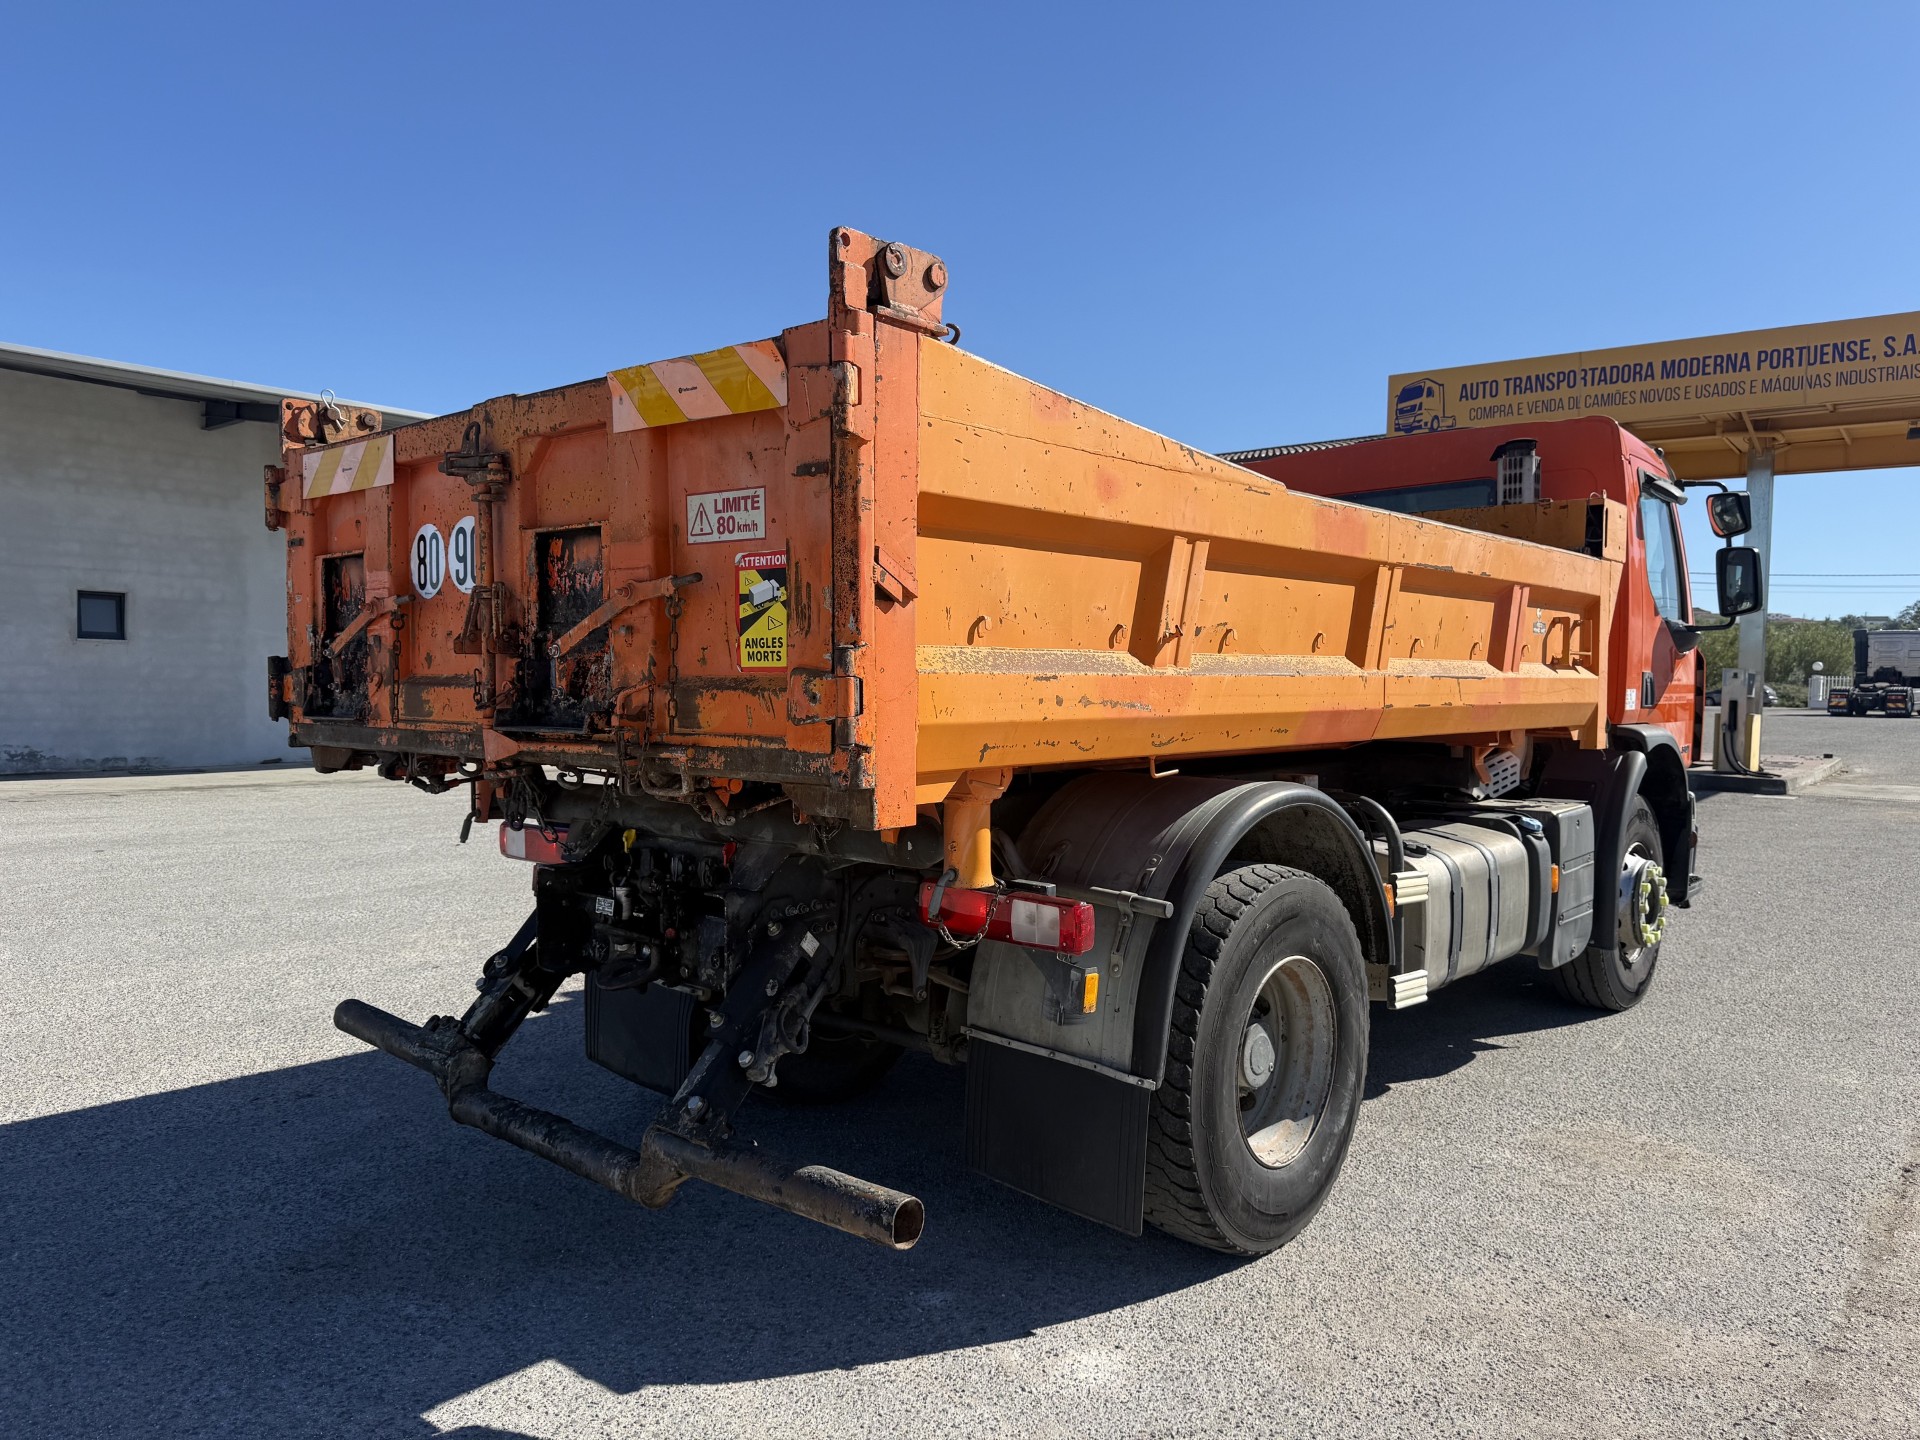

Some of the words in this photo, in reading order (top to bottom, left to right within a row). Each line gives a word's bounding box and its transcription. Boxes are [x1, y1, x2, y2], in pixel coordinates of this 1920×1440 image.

[1459, 379, 1499, 402] AUTO
[1660, 352, 1751, 380] MODERNA
[1757, 338, 1877, 371] PORTUENSE,
[1468, 403, 1514, 421] COMPRA
[1517, 402, 1524, 416] E
[1527, 398, 1564, 414] VENDA
[1584, 389, 1636, 408] CAMIÕES
[1640, 386, 1680, 404] NOVOS
[1684, 385, 1692, 400] E
[1695, 380, 1746, 399] USADOS
[1750, 380, 1758, 394] E
[1761, 372, 1832, 394] MÁQUINAS
[1836, 363, 1920, 387] INDUSTRIAIS
[714, 490, 760, 514] LIMITÉ
[716, 515, 736, 535] 80
[737, 520, 758, 533] km/h
[417, 532, 440, 591] 80
[739, 554, 787, 568] ATTENTION
[744, 636, 784, 649] ANGLES
[747, 650, 782, 662] MORTS
